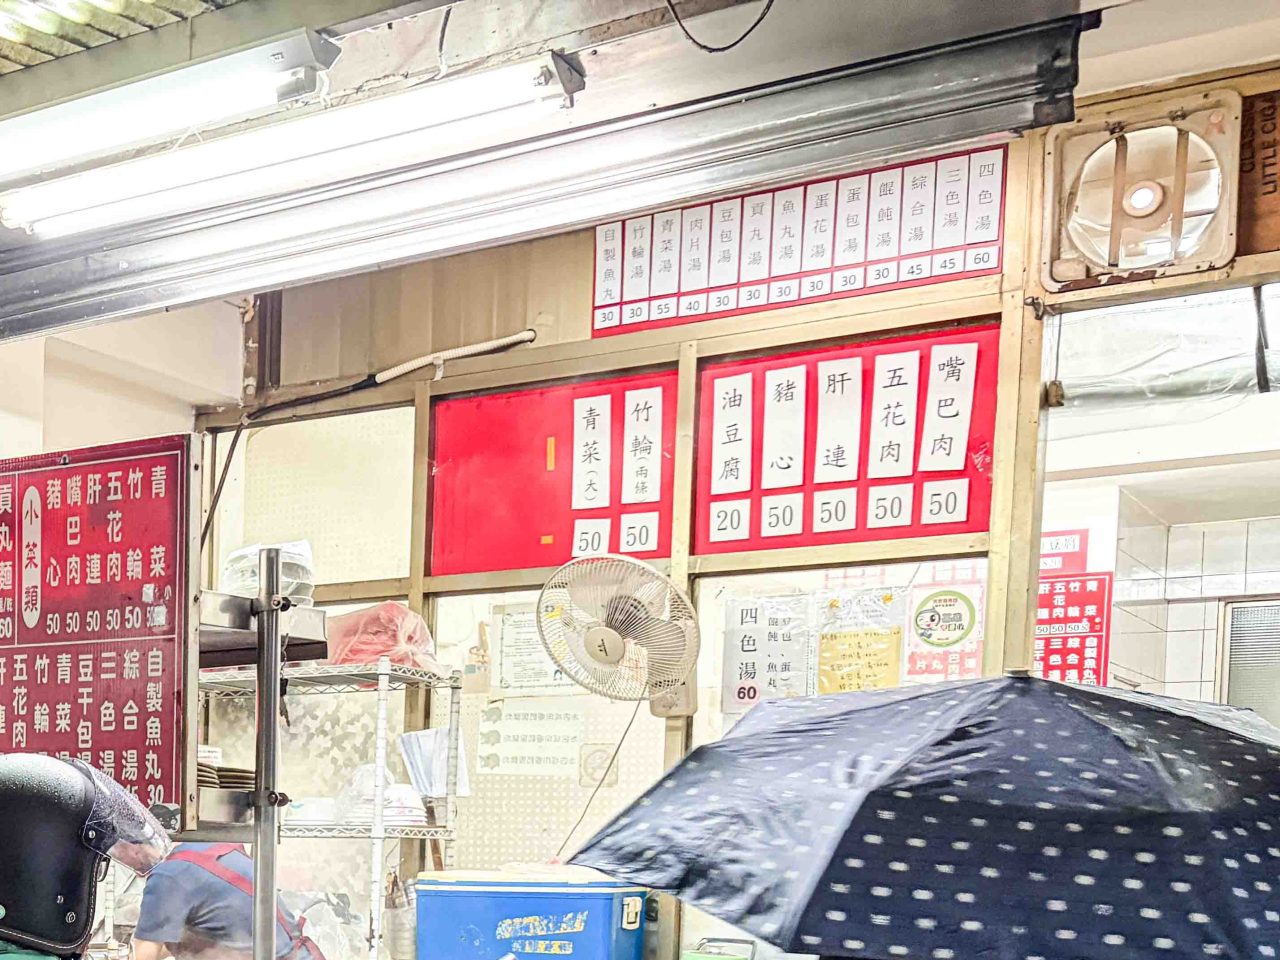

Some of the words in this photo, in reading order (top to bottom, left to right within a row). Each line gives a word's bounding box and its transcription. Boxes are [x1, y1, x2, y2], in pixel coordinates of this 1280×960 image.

[843, 187, 861, 253] 蛋包湯
[876, 181, 894, 247] 餛飩湯
[908, 176, 927, 242] 綜合湯
[943, 169, 960, 228] 三色湯
[975, 163, 994, 230] 四色湯
[659, 219, 673, 272] 青菜湯
[688, 218, 703, 272] 肉片湯
[718, 208, 733, 263] 豆包湯
[748, 202, 764, 266] 貢丸湯
[779, 200, 795, 260] 魚丸湯
[810, 193, 829, 258] 蛋花湯
[603, 229, 615, 300] 自製魚丸
[631, 226, 645, 279] 竹輪湯
[875, 268, 889, 279] 30
[907, 264, 922, 275] 45
[940, 258, 956, 270] 45
[974, 252, 990, 264] 60
[686, 301, 699, 311] 40
[716, 296, 729, 307] 30
[746, 289, 760, 300] 30
[777, 286, 791, 297] 30
[809, 280, 823, 291] 30
[841, 275, 856, 286] 30
[600, 312, 613, 322] 30
[629, 307, 642, 318] 30
[657, 304, 670, 314] 55
[770, 379, 796, 470] 豬心
[823, 372, 851, 468] 肝連
[880, 367, 908, 463] 五花肉
[931, 356, 965, 456] 嘴巴肉
[719, 388, 743, 480] 油豆腐
[67, 474, 82, 585] 嘴巴肉
[86, 473, 101, 584] 肝連
[107, 471, 122, 582] 五花肉
[127, 467, 143, 580] 竹輪
[150, 465, 167, 578] 青菜
[717, 509, 740, 531] 20
[769, 505, 793, 528] 50
[820, 500, 846, 523] 50
[875, 496, 902, 519] 50
[929, 492, 957, 515] 50
[25, 500, 38, 612] 小菜類
[46, 478, 61, 587] 豬心
[579, 532, 601, 551] 50
[626, 526, 649, 546] 50
[47, 613, 60, 635] 50
[66, 612, 80, 633] 50
[86, 610, 100, 632] 50
[106, 609, 120, 630] 50
[125, 606, 141, 628] 50
[739, 607, 758, 680] 四色湯
[34, 654, 49, 755] 竹輪
[99, 652, 116, 779] 三色湯
[122, 649, 140, 781] 綜合湯
[146, 648, 162, 780] 自製魚丸
[737, 686, 757, 700] 60
[148, 785, 163, 806] 30
